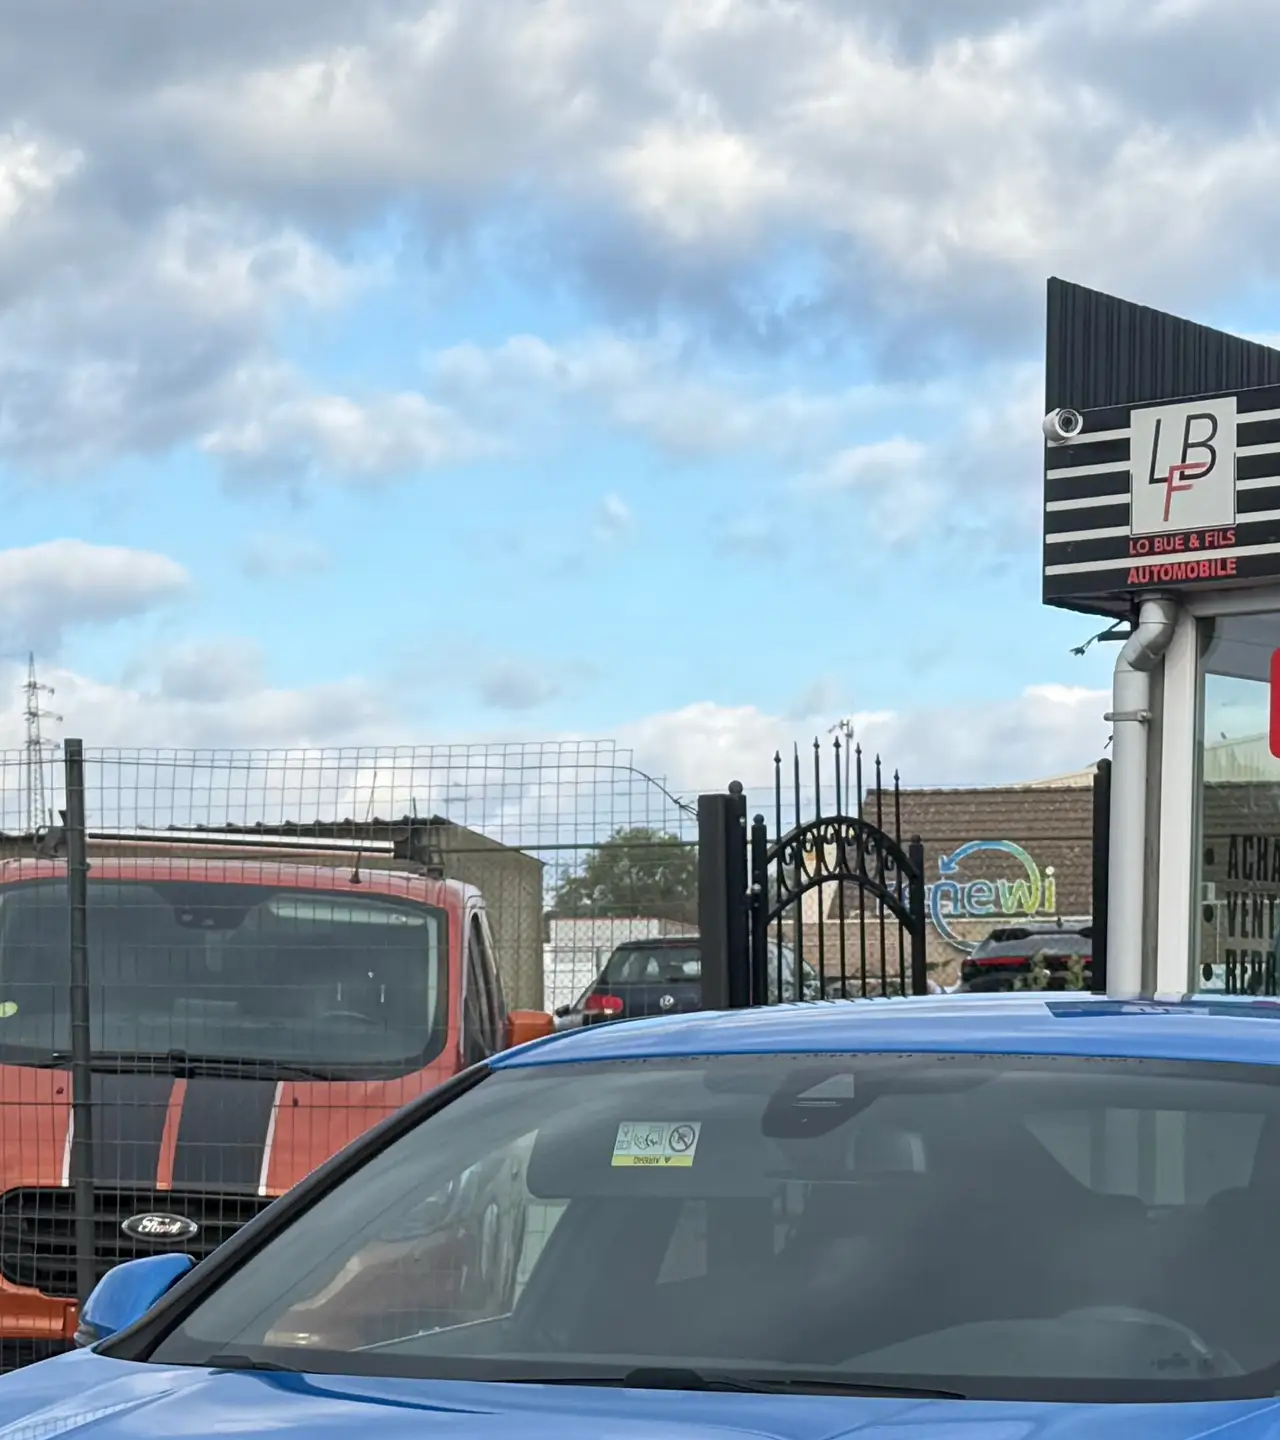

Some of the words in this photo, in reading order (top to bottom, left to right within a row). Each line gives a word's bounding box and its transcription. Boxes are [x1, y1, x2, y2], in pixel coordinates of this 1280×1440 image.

[1129, 539, 1150, 555] LO
[1154, 535, 1185, 552] BUE
[1189, 533, 1200, 549] &
[1205, 530, 1236, 547] FILS
[1127, 558, 1237, 585] AUTOMOBILE
[885, 866, 1056, 914] newi
[1225, 948, 1277, 996] REPR
[138, 1216, 181, 1233] Ford
